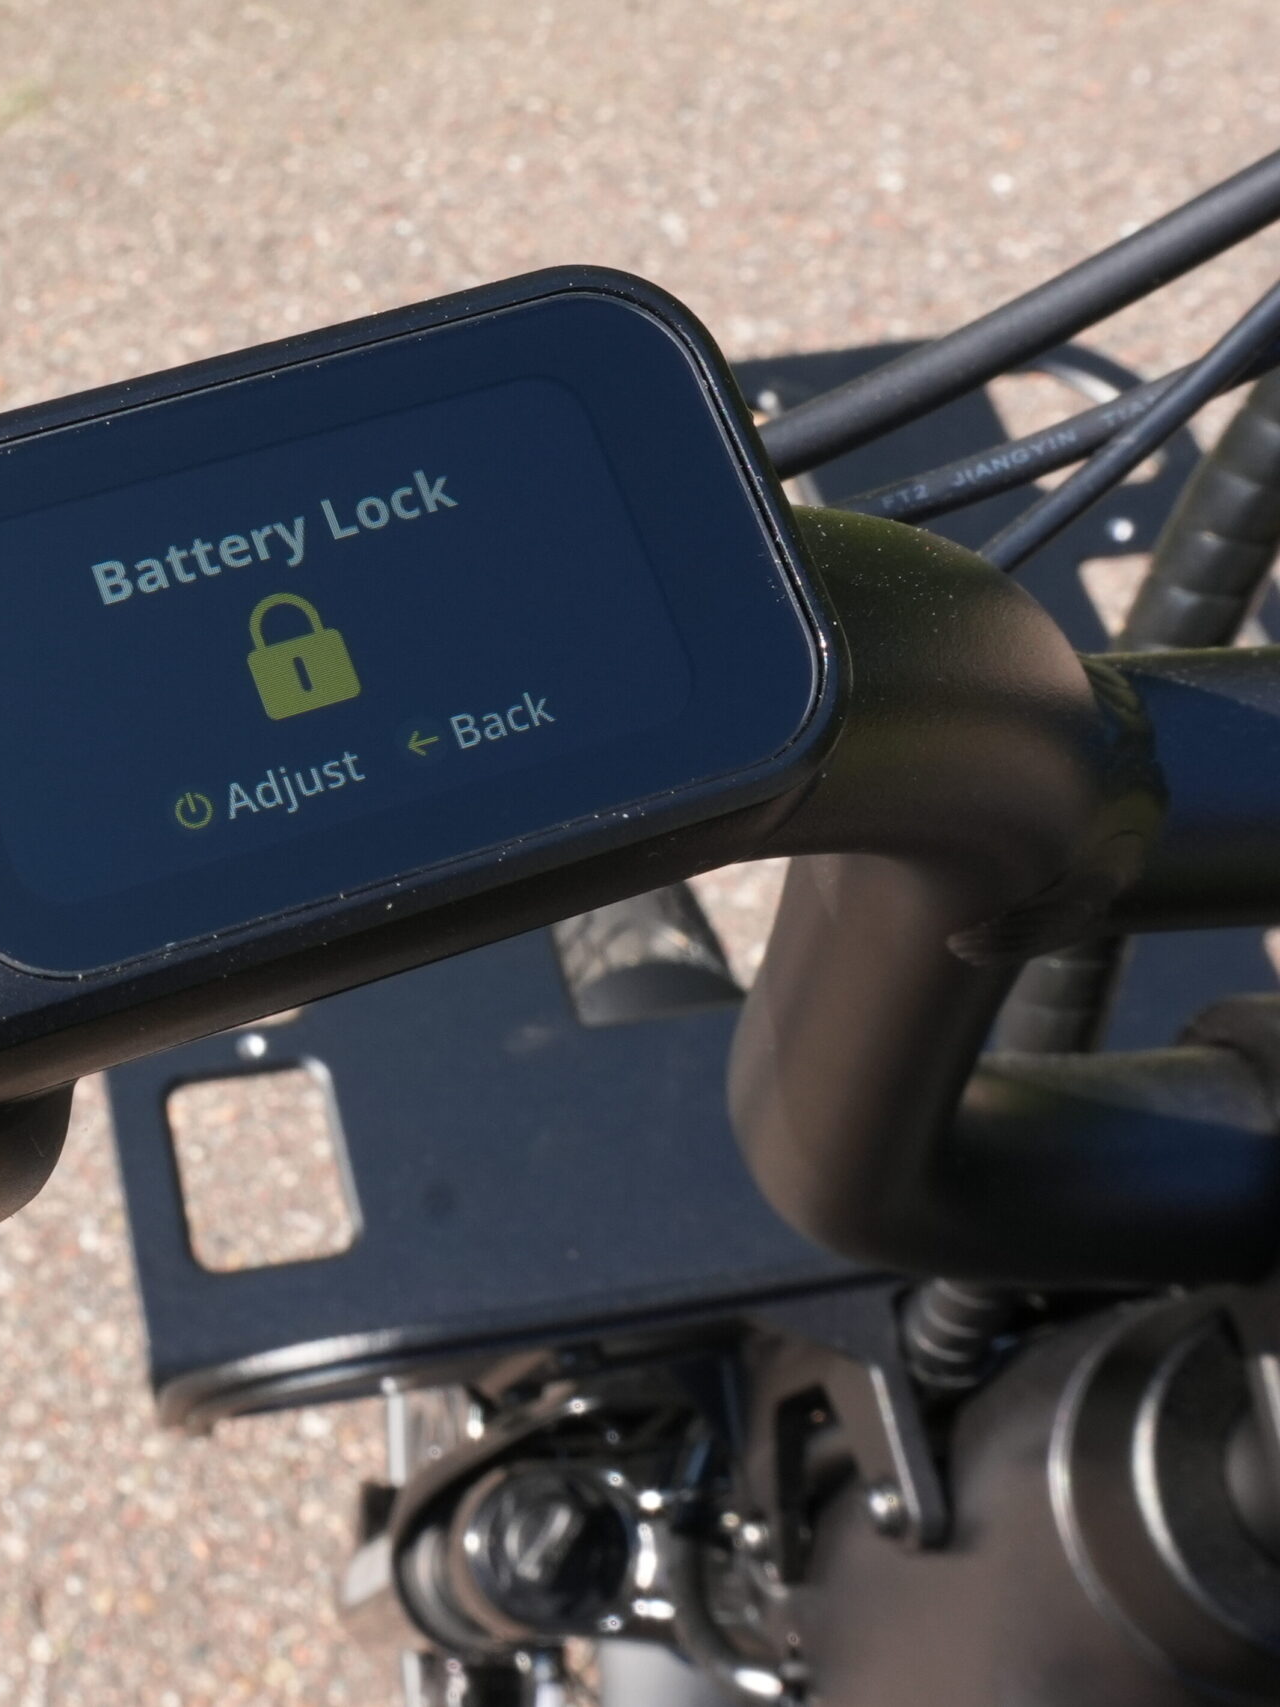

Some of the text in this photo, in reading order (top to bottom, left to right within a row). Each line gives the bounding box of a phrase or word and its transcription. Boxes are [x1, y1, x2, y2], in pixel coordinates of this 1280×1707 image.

[951, 429, 1078, 489] JIANGYIN
[91, 469, 459, 606] Battery Lock
[449, 692, 556, 751] Back
[226, 750, 366, 820] Adjust
